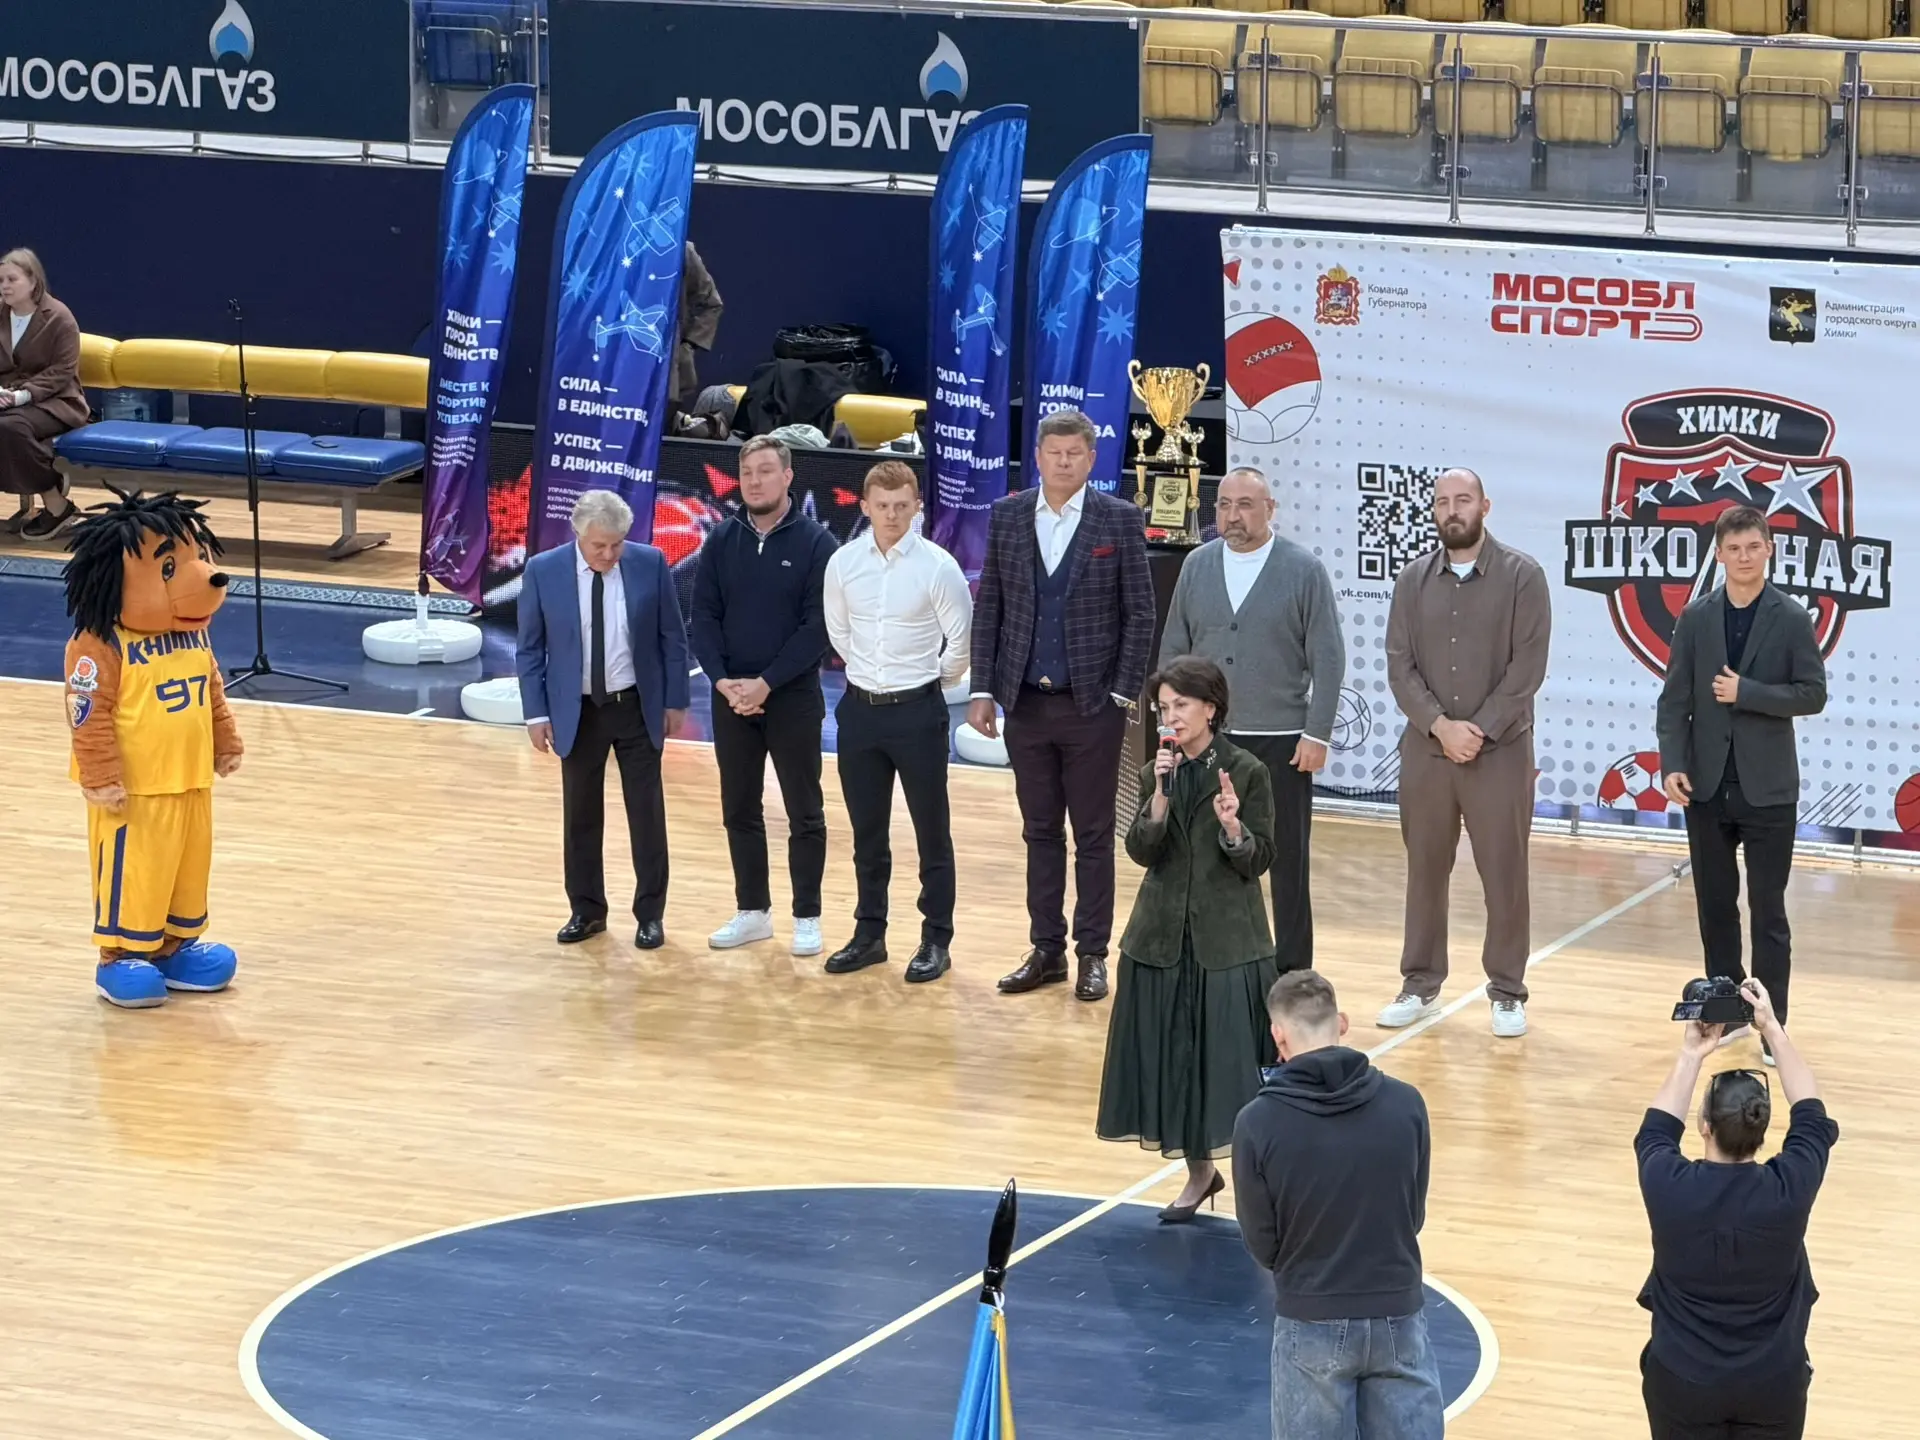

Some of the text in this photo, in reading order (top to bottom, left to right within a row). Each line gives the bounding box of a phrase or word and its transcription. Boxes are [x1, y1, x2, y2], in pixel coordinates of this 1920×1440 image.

[675, 97, 983, 152] МОСОБЛГА
[1367, 283, 1409, 296] Команда
[1492, 272, 1695, 310] МОСОБЛ
[1367, 297, 1427, 311] Губернатора
[1824, 300, 1905, 314] Администрация
[1491, 304, 1651, 339] СПОРТ
[1825, 315, 1917, 330] городского округа
[445, 325, 480, 347] ГОРОД
[1823, 327, 1857, 338] Химки
[559, 376, 602, 394] СИЛА
[936, 386, 944, 401] В
[557, 398, 567, 411] В
[934, 421, 976, 442] УСПЕХ
[1676, 405, 1781, 440] ХИМКИ
[553, 432, 602, 452] УСПЕХ
[550, 454, 560, 467] В
[1571, 525, 1885, 603] ШКОНАЯ
[155, 674, 208, 714] 97
